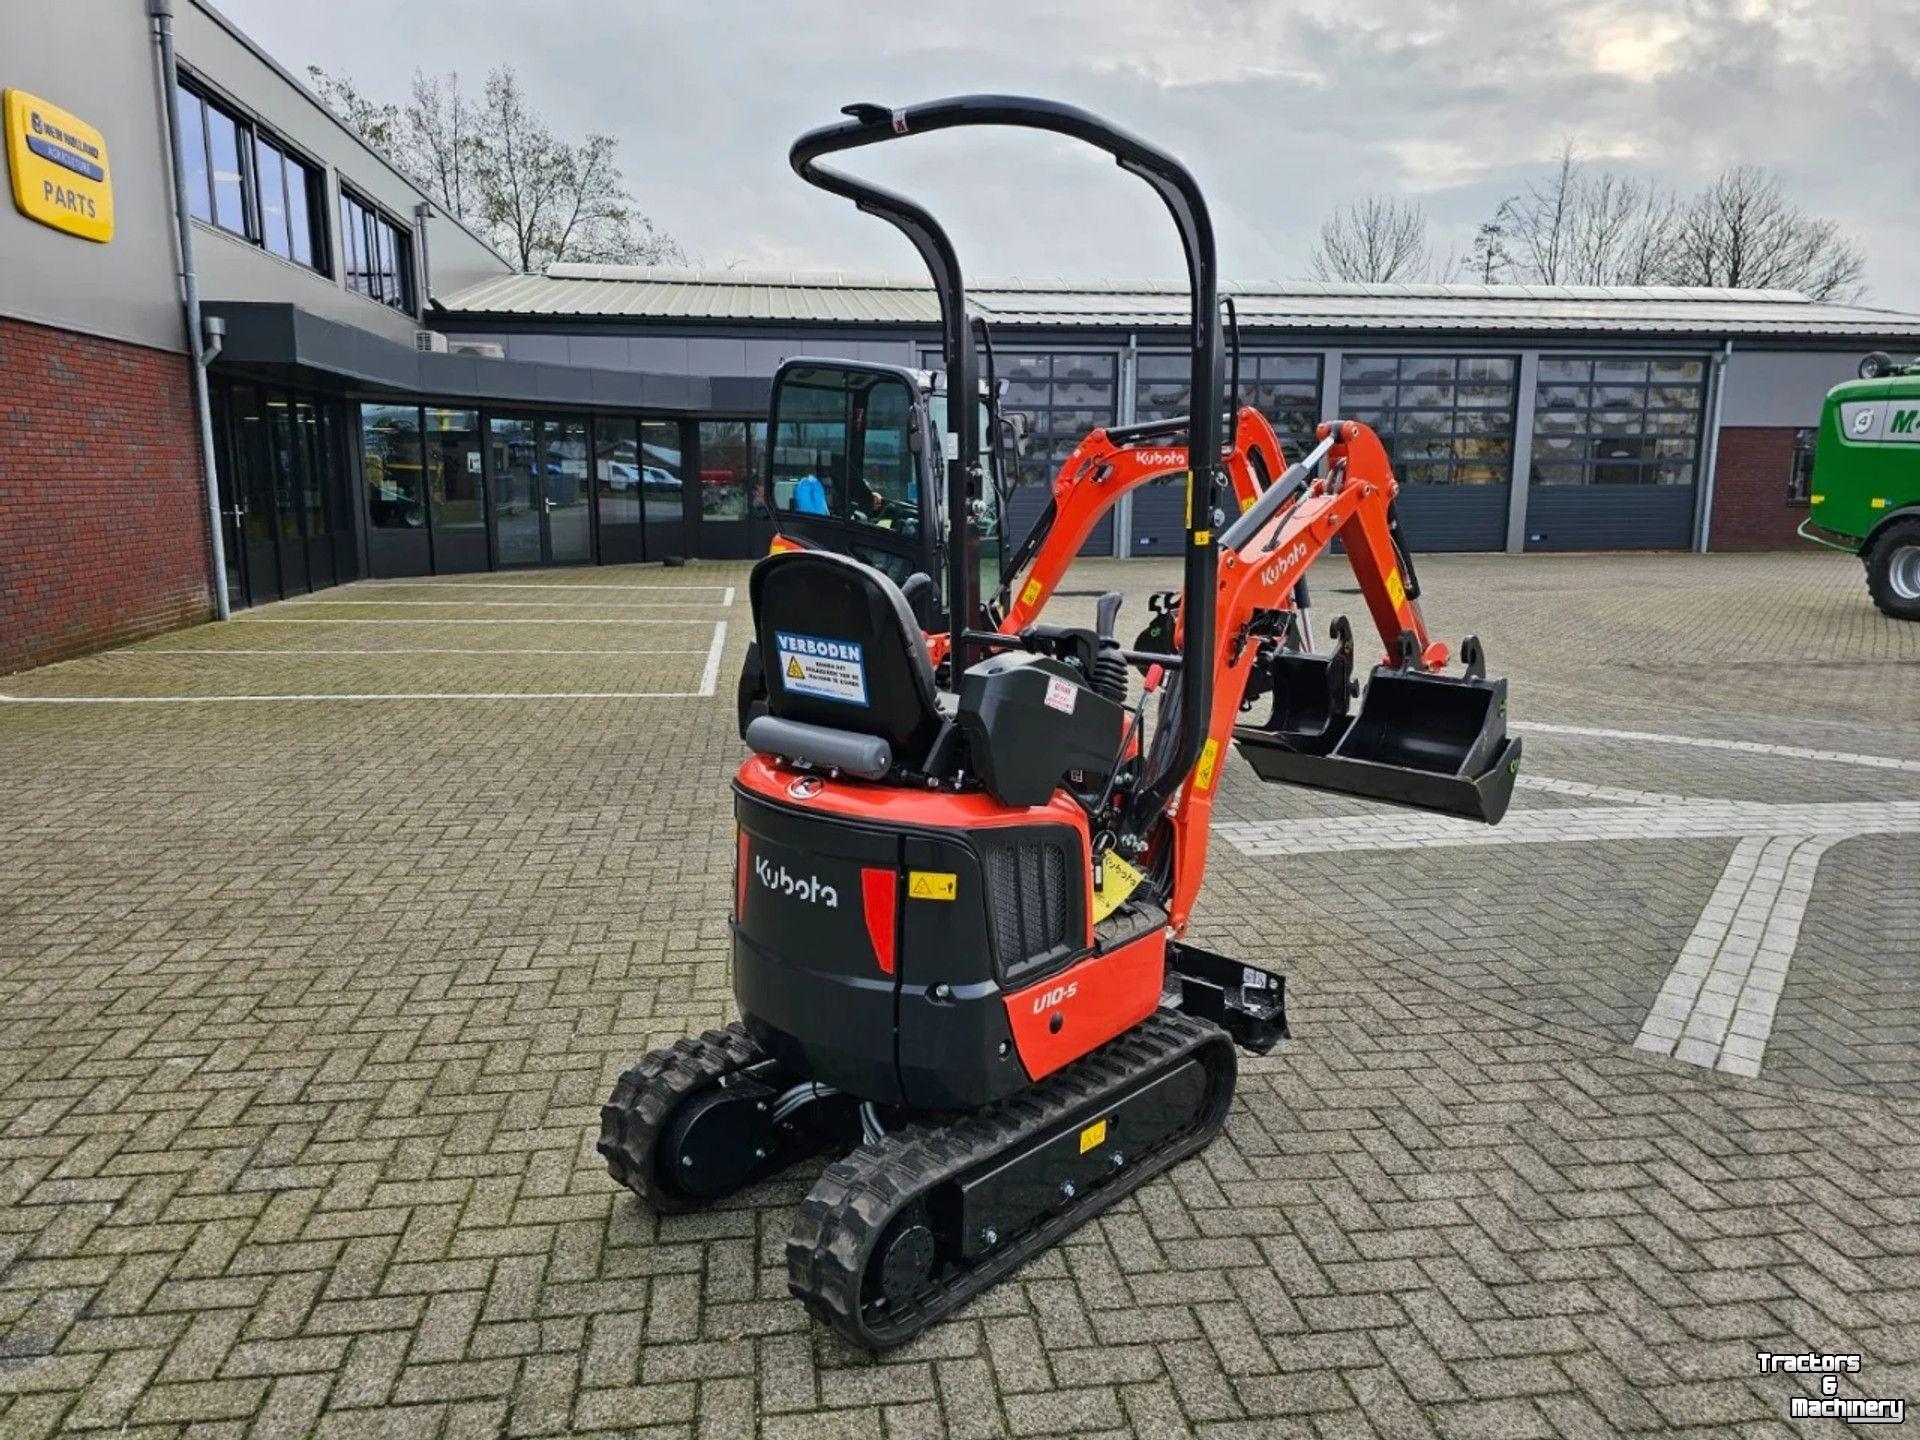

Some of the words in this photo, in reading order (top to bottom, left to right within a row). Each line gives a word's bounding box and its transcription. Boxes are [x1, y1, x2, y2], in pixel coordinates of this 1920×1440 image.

[44, 122, 63, 141] NEW
[65, 133, 99, 159] HOLLAND
[43, 180, 96, 219] PARTS
[1889, 409, 1920, 434] M
[1136, 450, 1185, 465] Kubota
[1261, 542, 1307, 587] Kubota
[778, 635, 861, 662] VERBODEN
[755, 854, 838, 908] Kubota
